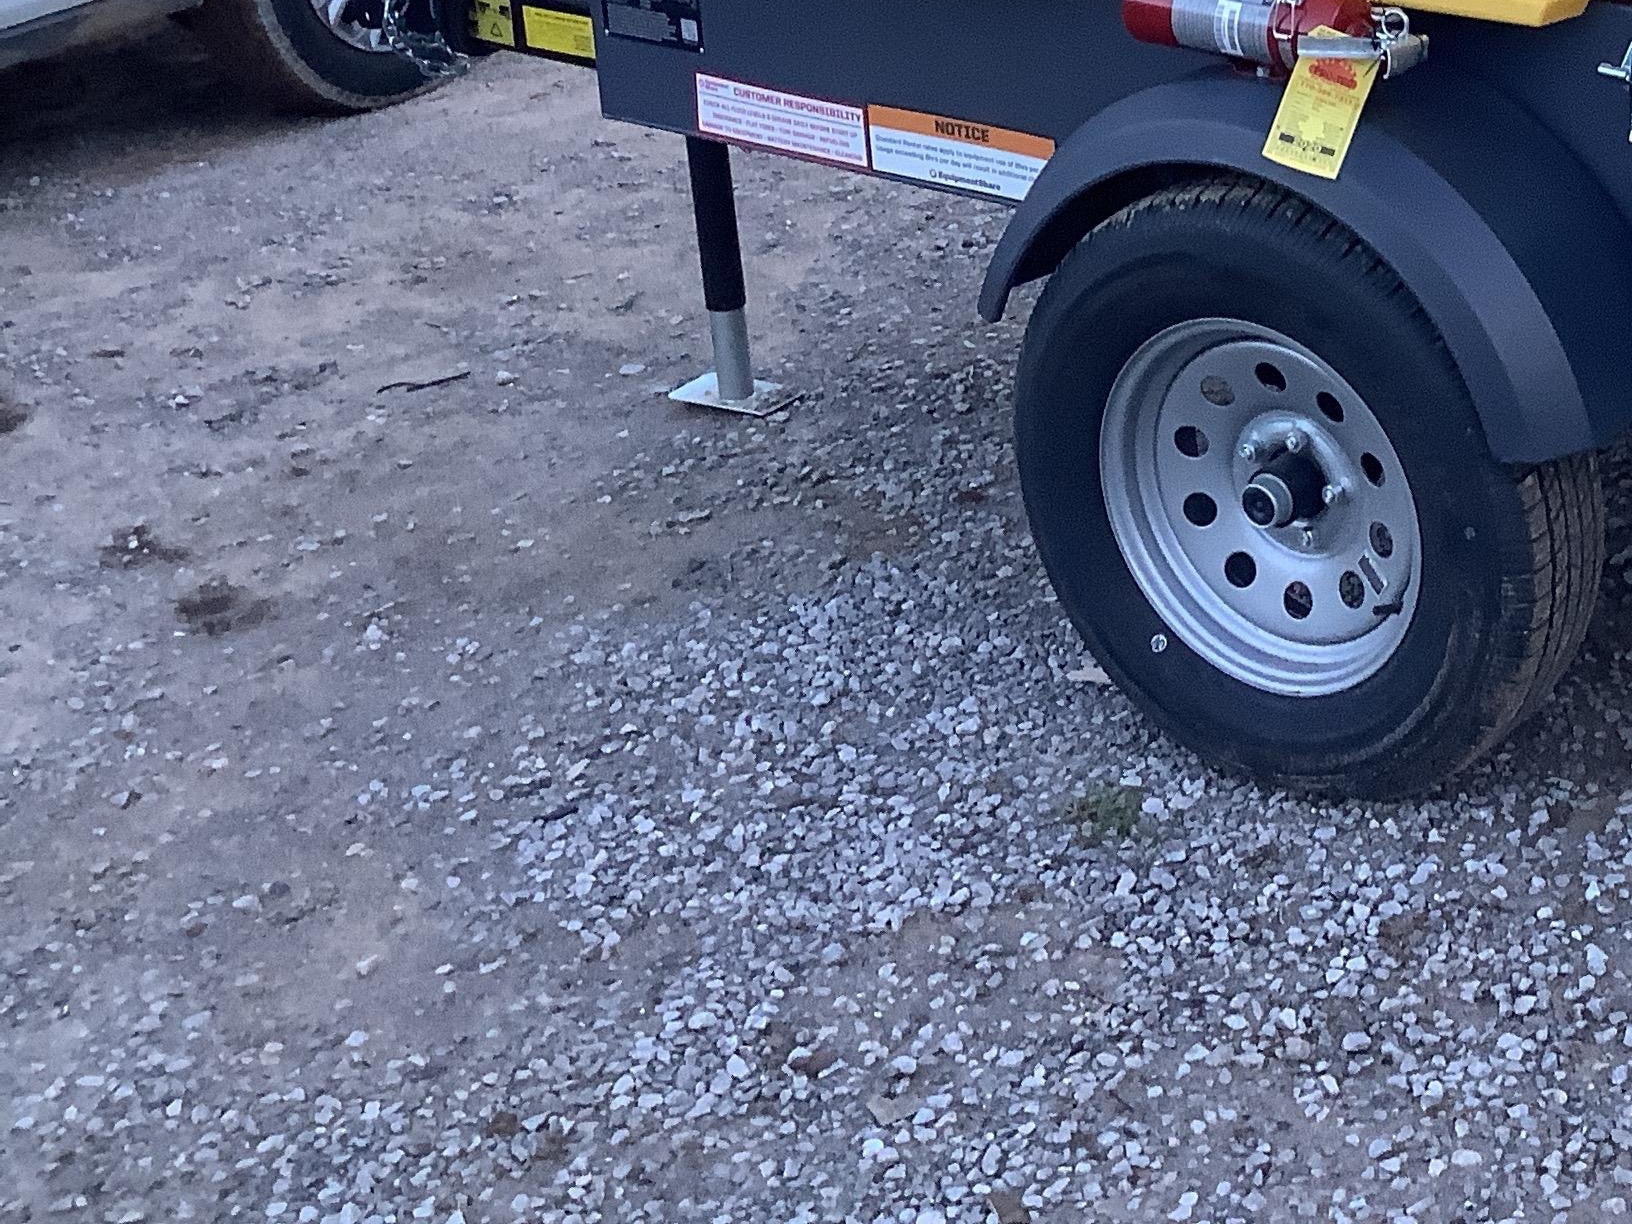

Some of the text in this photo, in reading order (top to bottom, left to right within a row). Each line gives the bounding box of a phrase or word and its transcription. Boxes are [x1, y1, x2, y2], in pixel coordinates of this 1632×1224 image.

[733, 86, 862, 123] CUSTOMER RESPONSIBILITY
[934, 119, 990, 143] NOTICE
